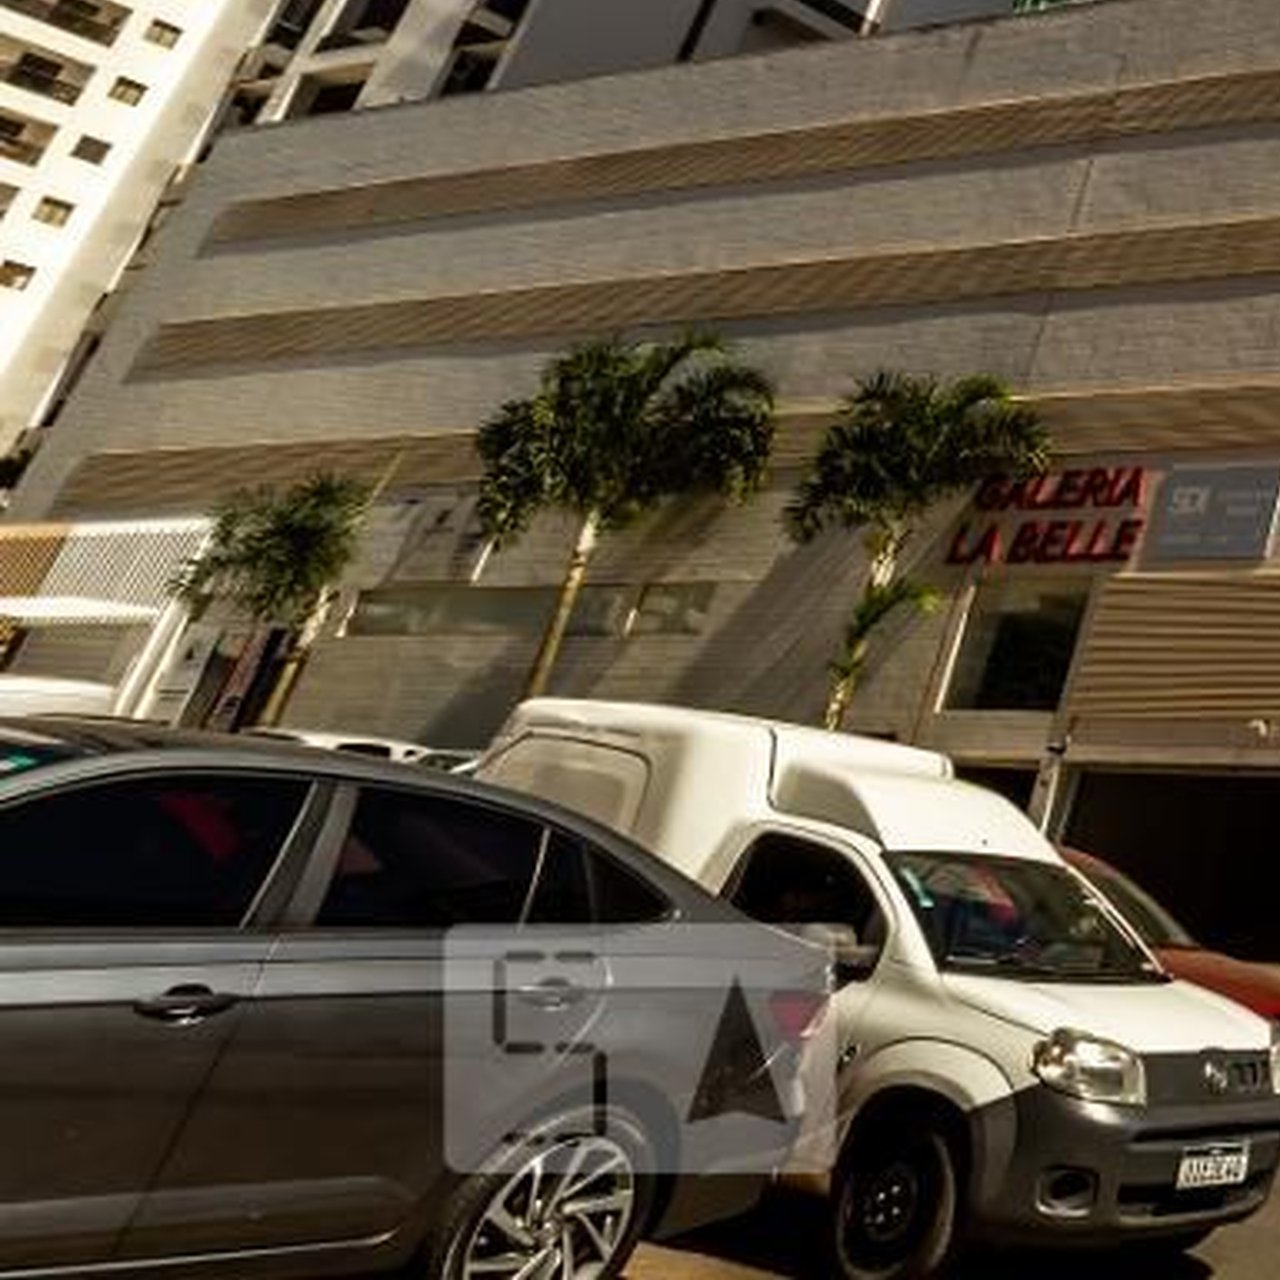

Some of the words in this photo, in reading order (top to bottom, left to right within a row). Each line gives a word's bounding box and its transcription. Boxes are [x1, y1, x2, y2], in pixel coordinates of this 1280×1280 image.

[974, 466, 1147, 510] GALERIA
[945, 520, 1002, 565] LA
[1005, 519, 1144, 564] BELLE
